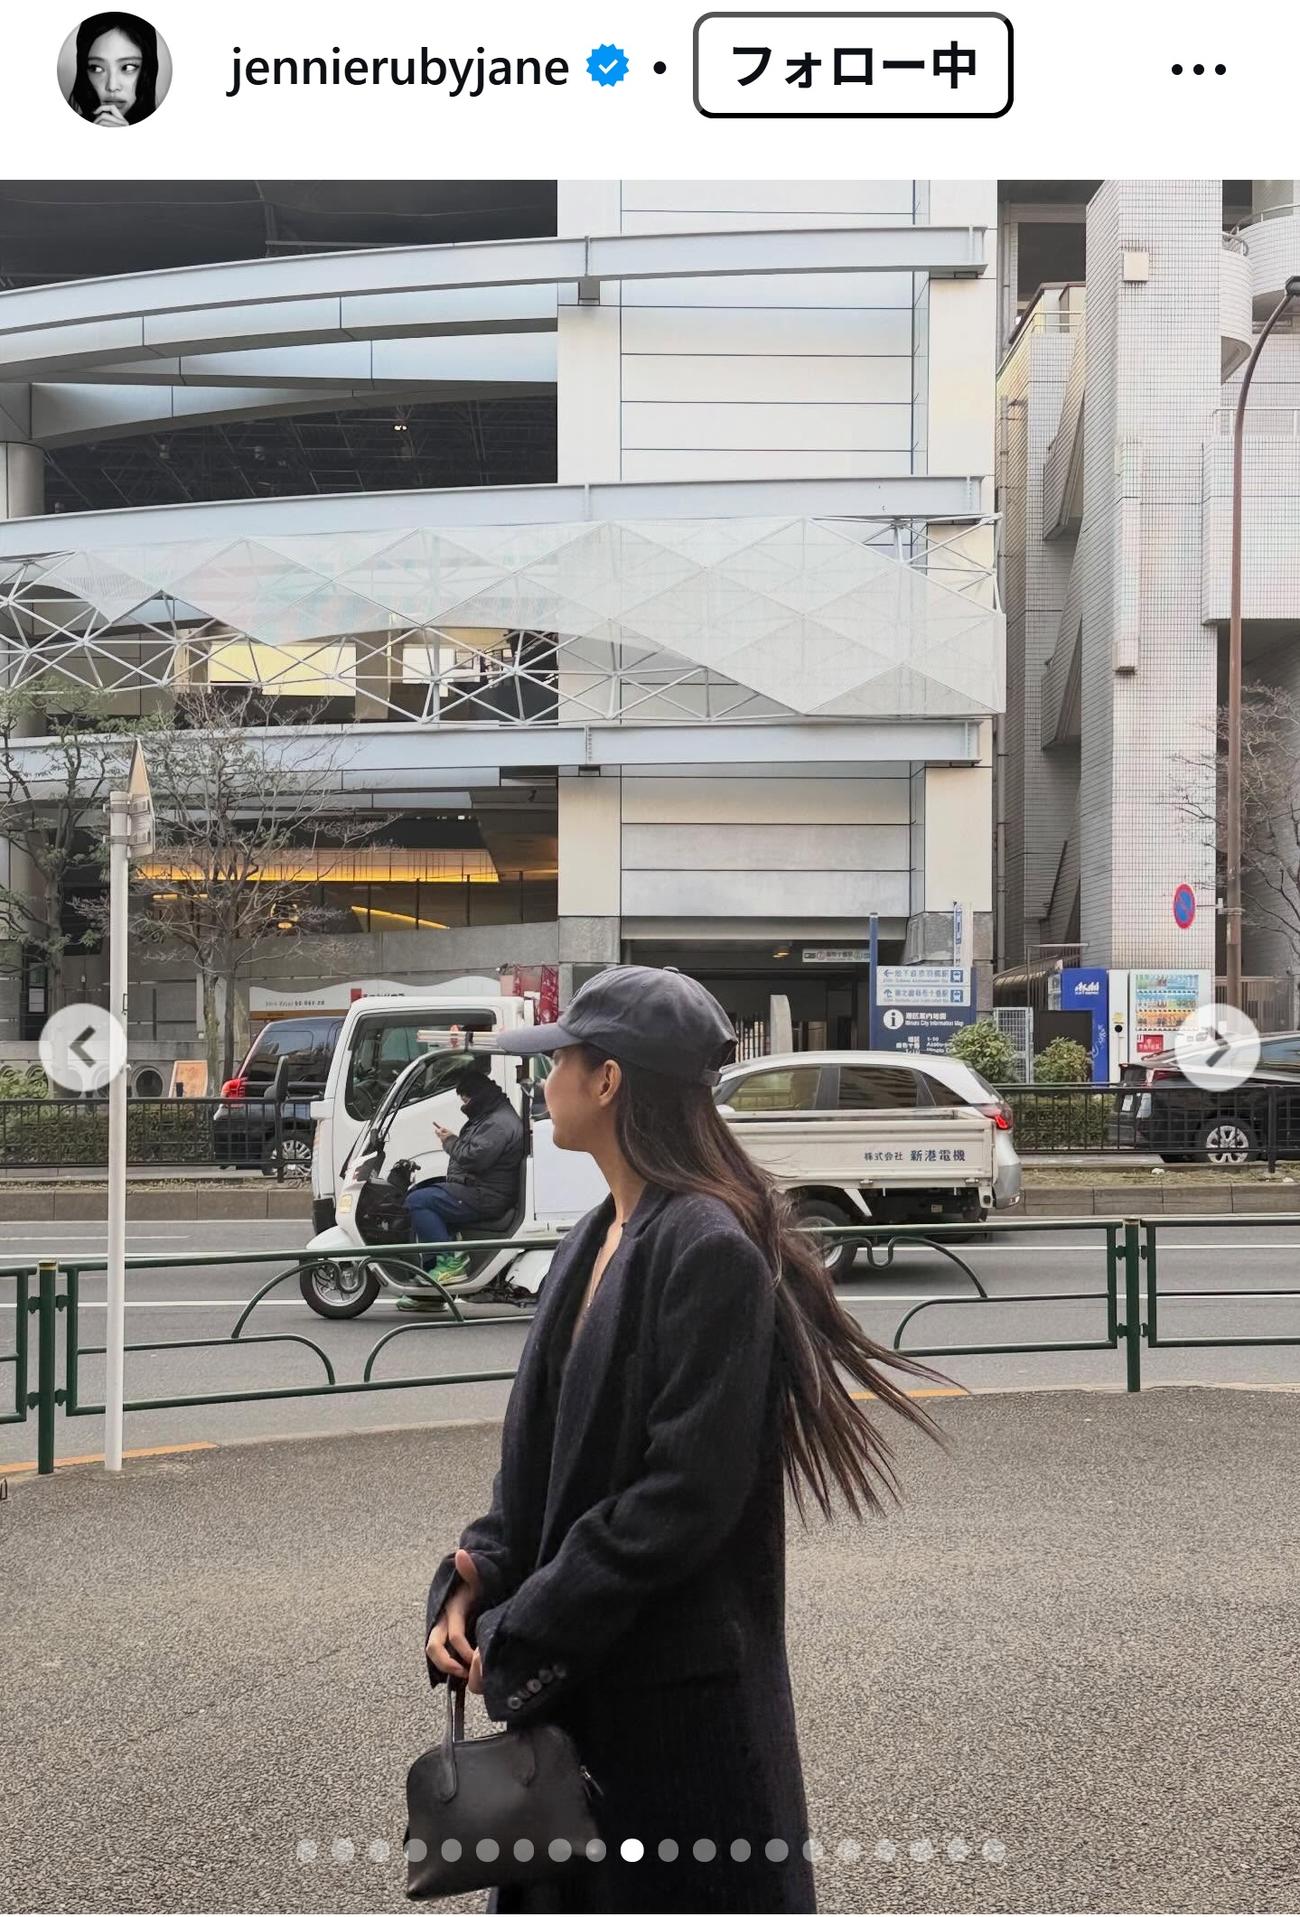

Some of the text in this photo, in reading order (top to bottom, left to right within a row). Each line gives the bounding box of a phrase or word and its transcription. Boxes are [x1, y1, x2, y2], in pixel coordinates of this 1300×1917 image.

[864, 1149, 966, 1162] 株式会社 新港電機
